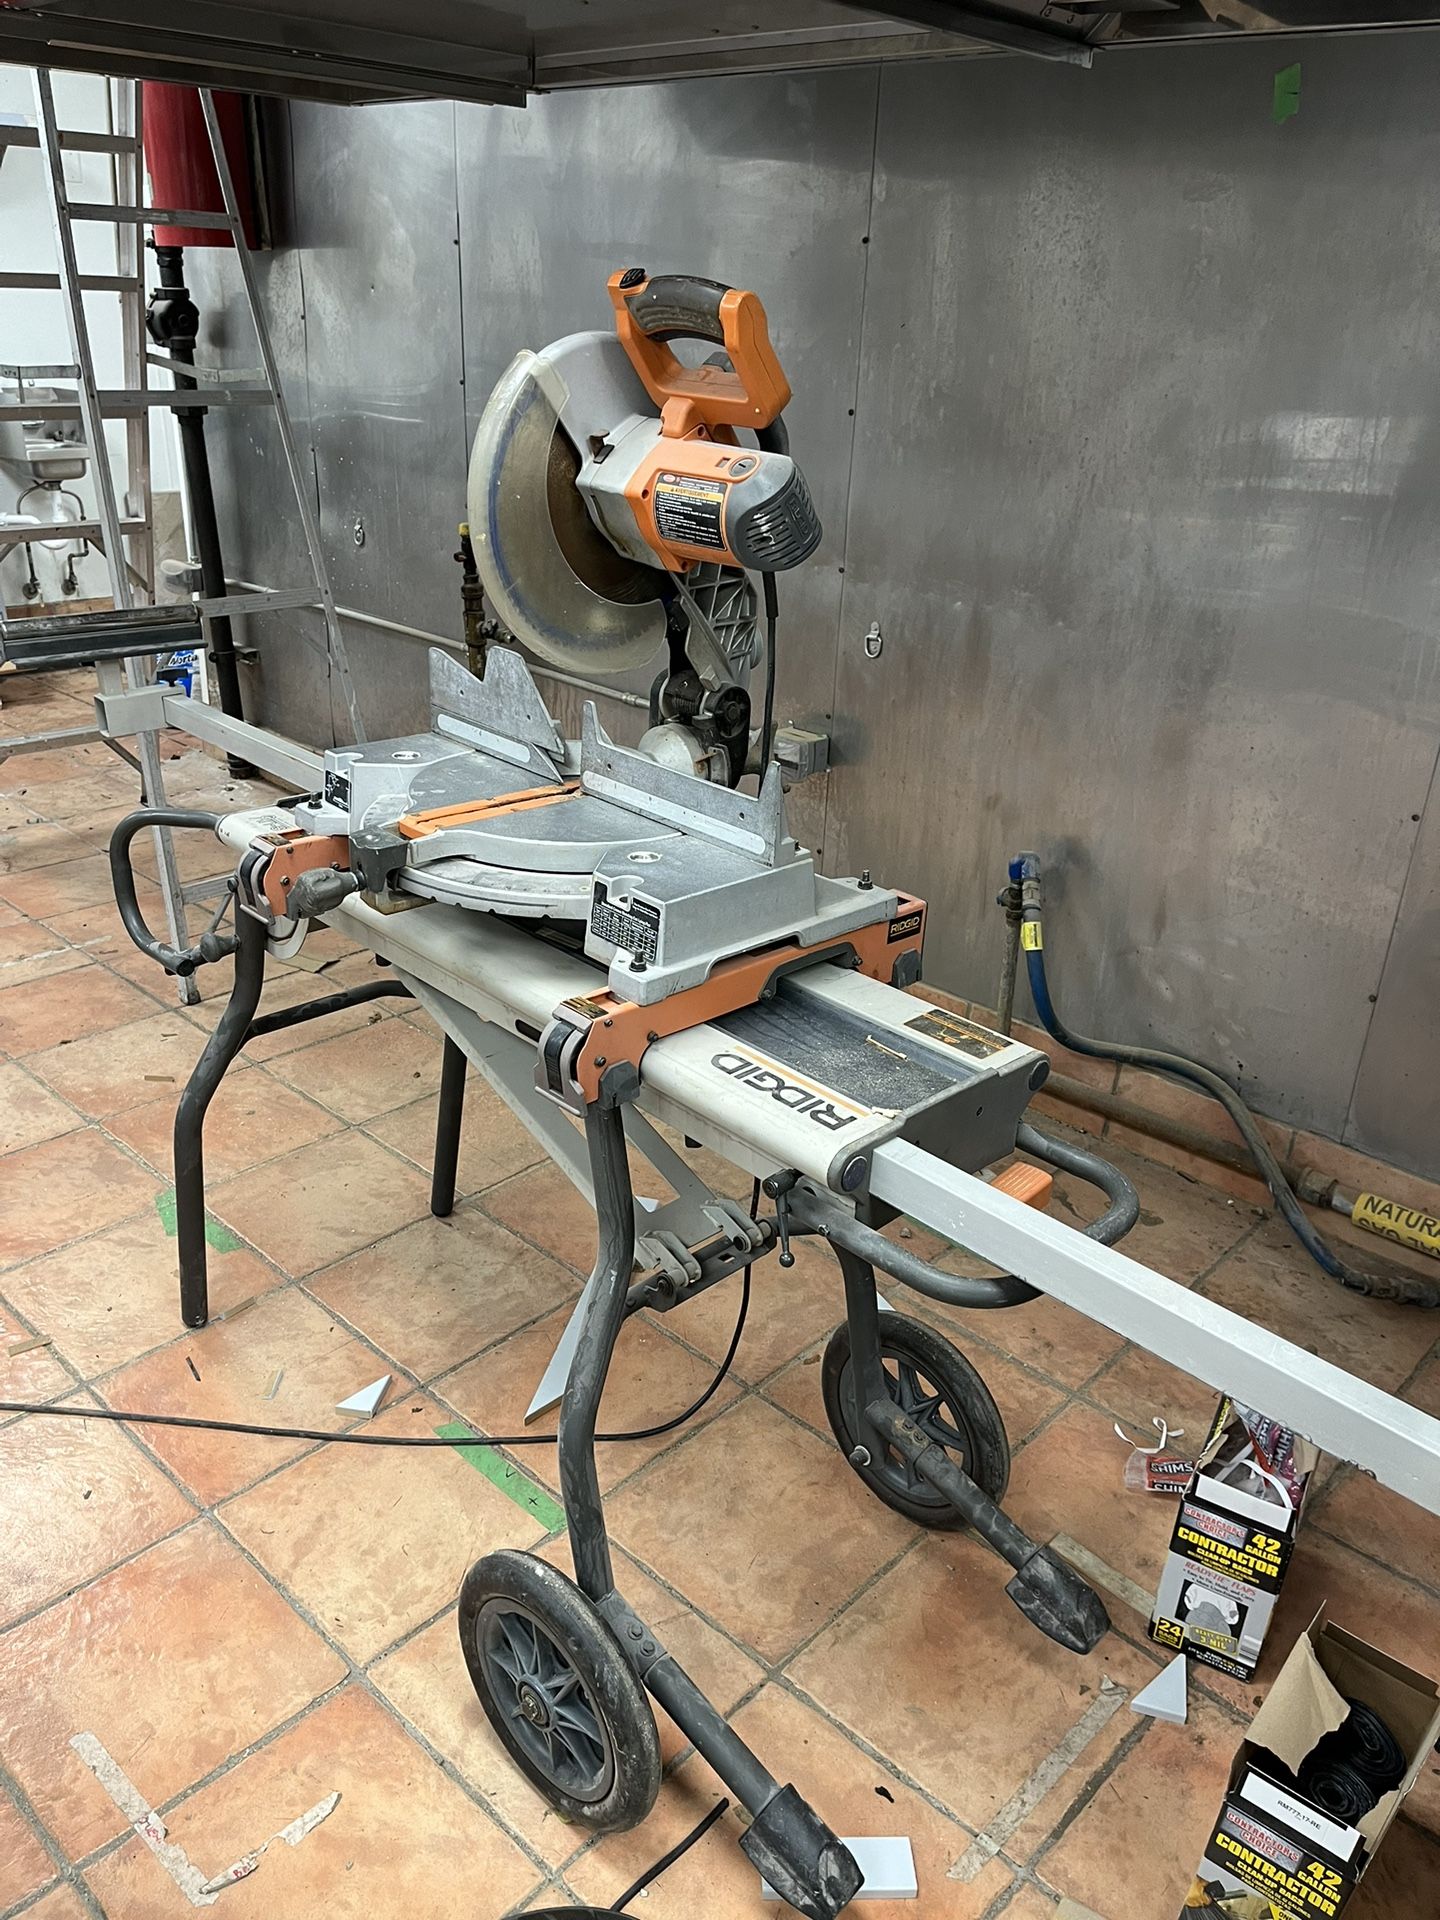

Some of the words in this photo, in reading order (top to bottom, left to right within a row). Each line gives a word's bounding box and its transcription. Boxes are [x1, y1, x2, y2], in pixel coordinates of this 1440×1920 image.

[890, 916, 920, 934] RIDGID
[711, 1053, 858, 1131] RIDGID
[1363, 1195, 1440, 1238] NATUR
[1150, 1460, 1195, 1474] SHIMS
[1177, 1526, 1279, 1578] CONTRACTOR
[1245, 1544, 1282, 1565] GALLON
[1252, 1533, 1282, 1556] 42
[1158, 1619, 1182, 1637] 24
[1226, 1811, 1300, 1862] CONTRACTOR'S
[1240, 1830, 1278, 1859] CHOICE
[1215, 1832, 1337, 1917] CONTRACTOR
[1236, 1860, 1278, 1889] CLEAN-UP
[1278, 1886, 1304, 1907] BAGS
[1296, 1870, 1341, 1904] GALLON
[1306, 1860, 1343, 1892] 42
